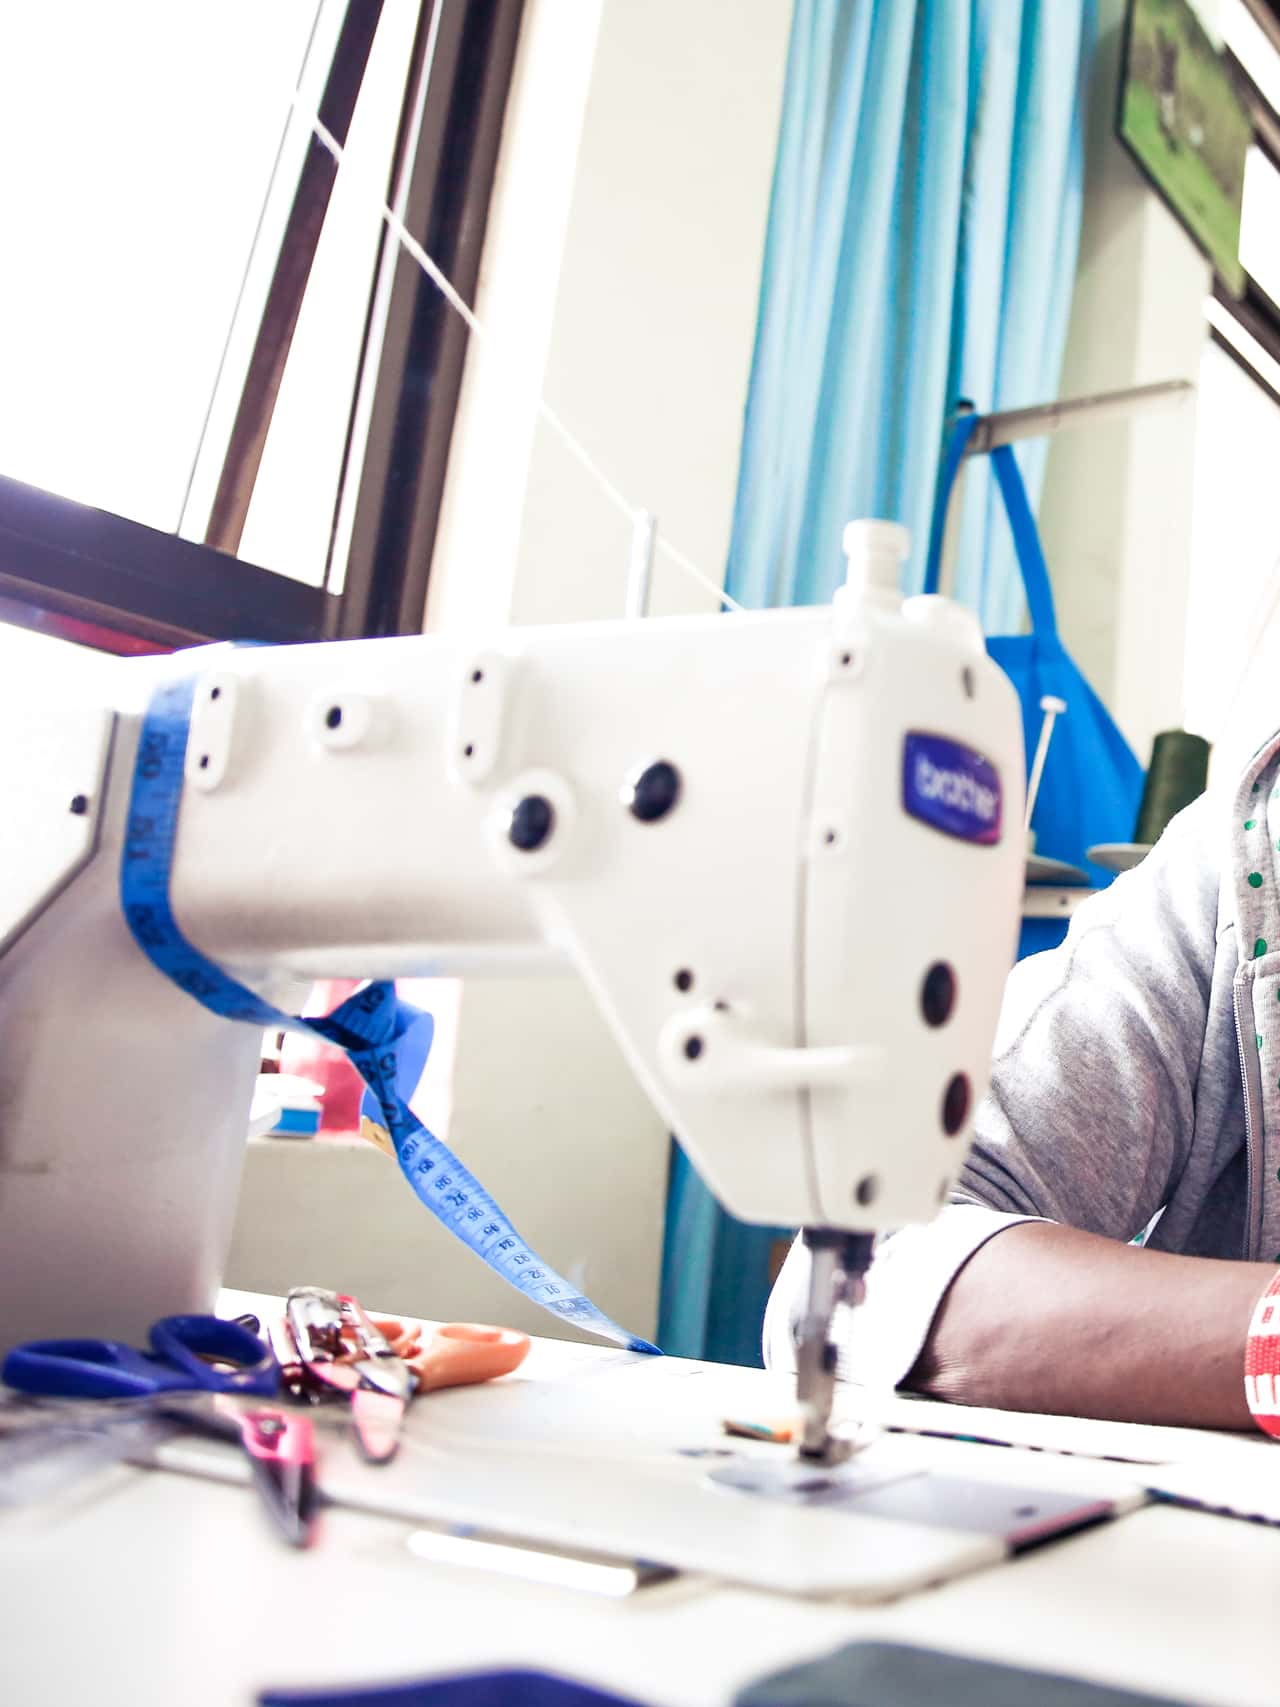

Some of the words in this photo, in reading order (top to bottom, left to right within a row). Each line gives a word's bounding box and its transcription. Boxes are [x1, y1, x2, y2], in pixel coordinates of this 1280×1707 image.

[914, 752, 997, 820] brother
[498, 1238, 516, 1251] 94
[513, 1253, 531, 1265] 93
[528, 1268, 546, 1280] 92
[543, 1285, 561, 1296] 91
